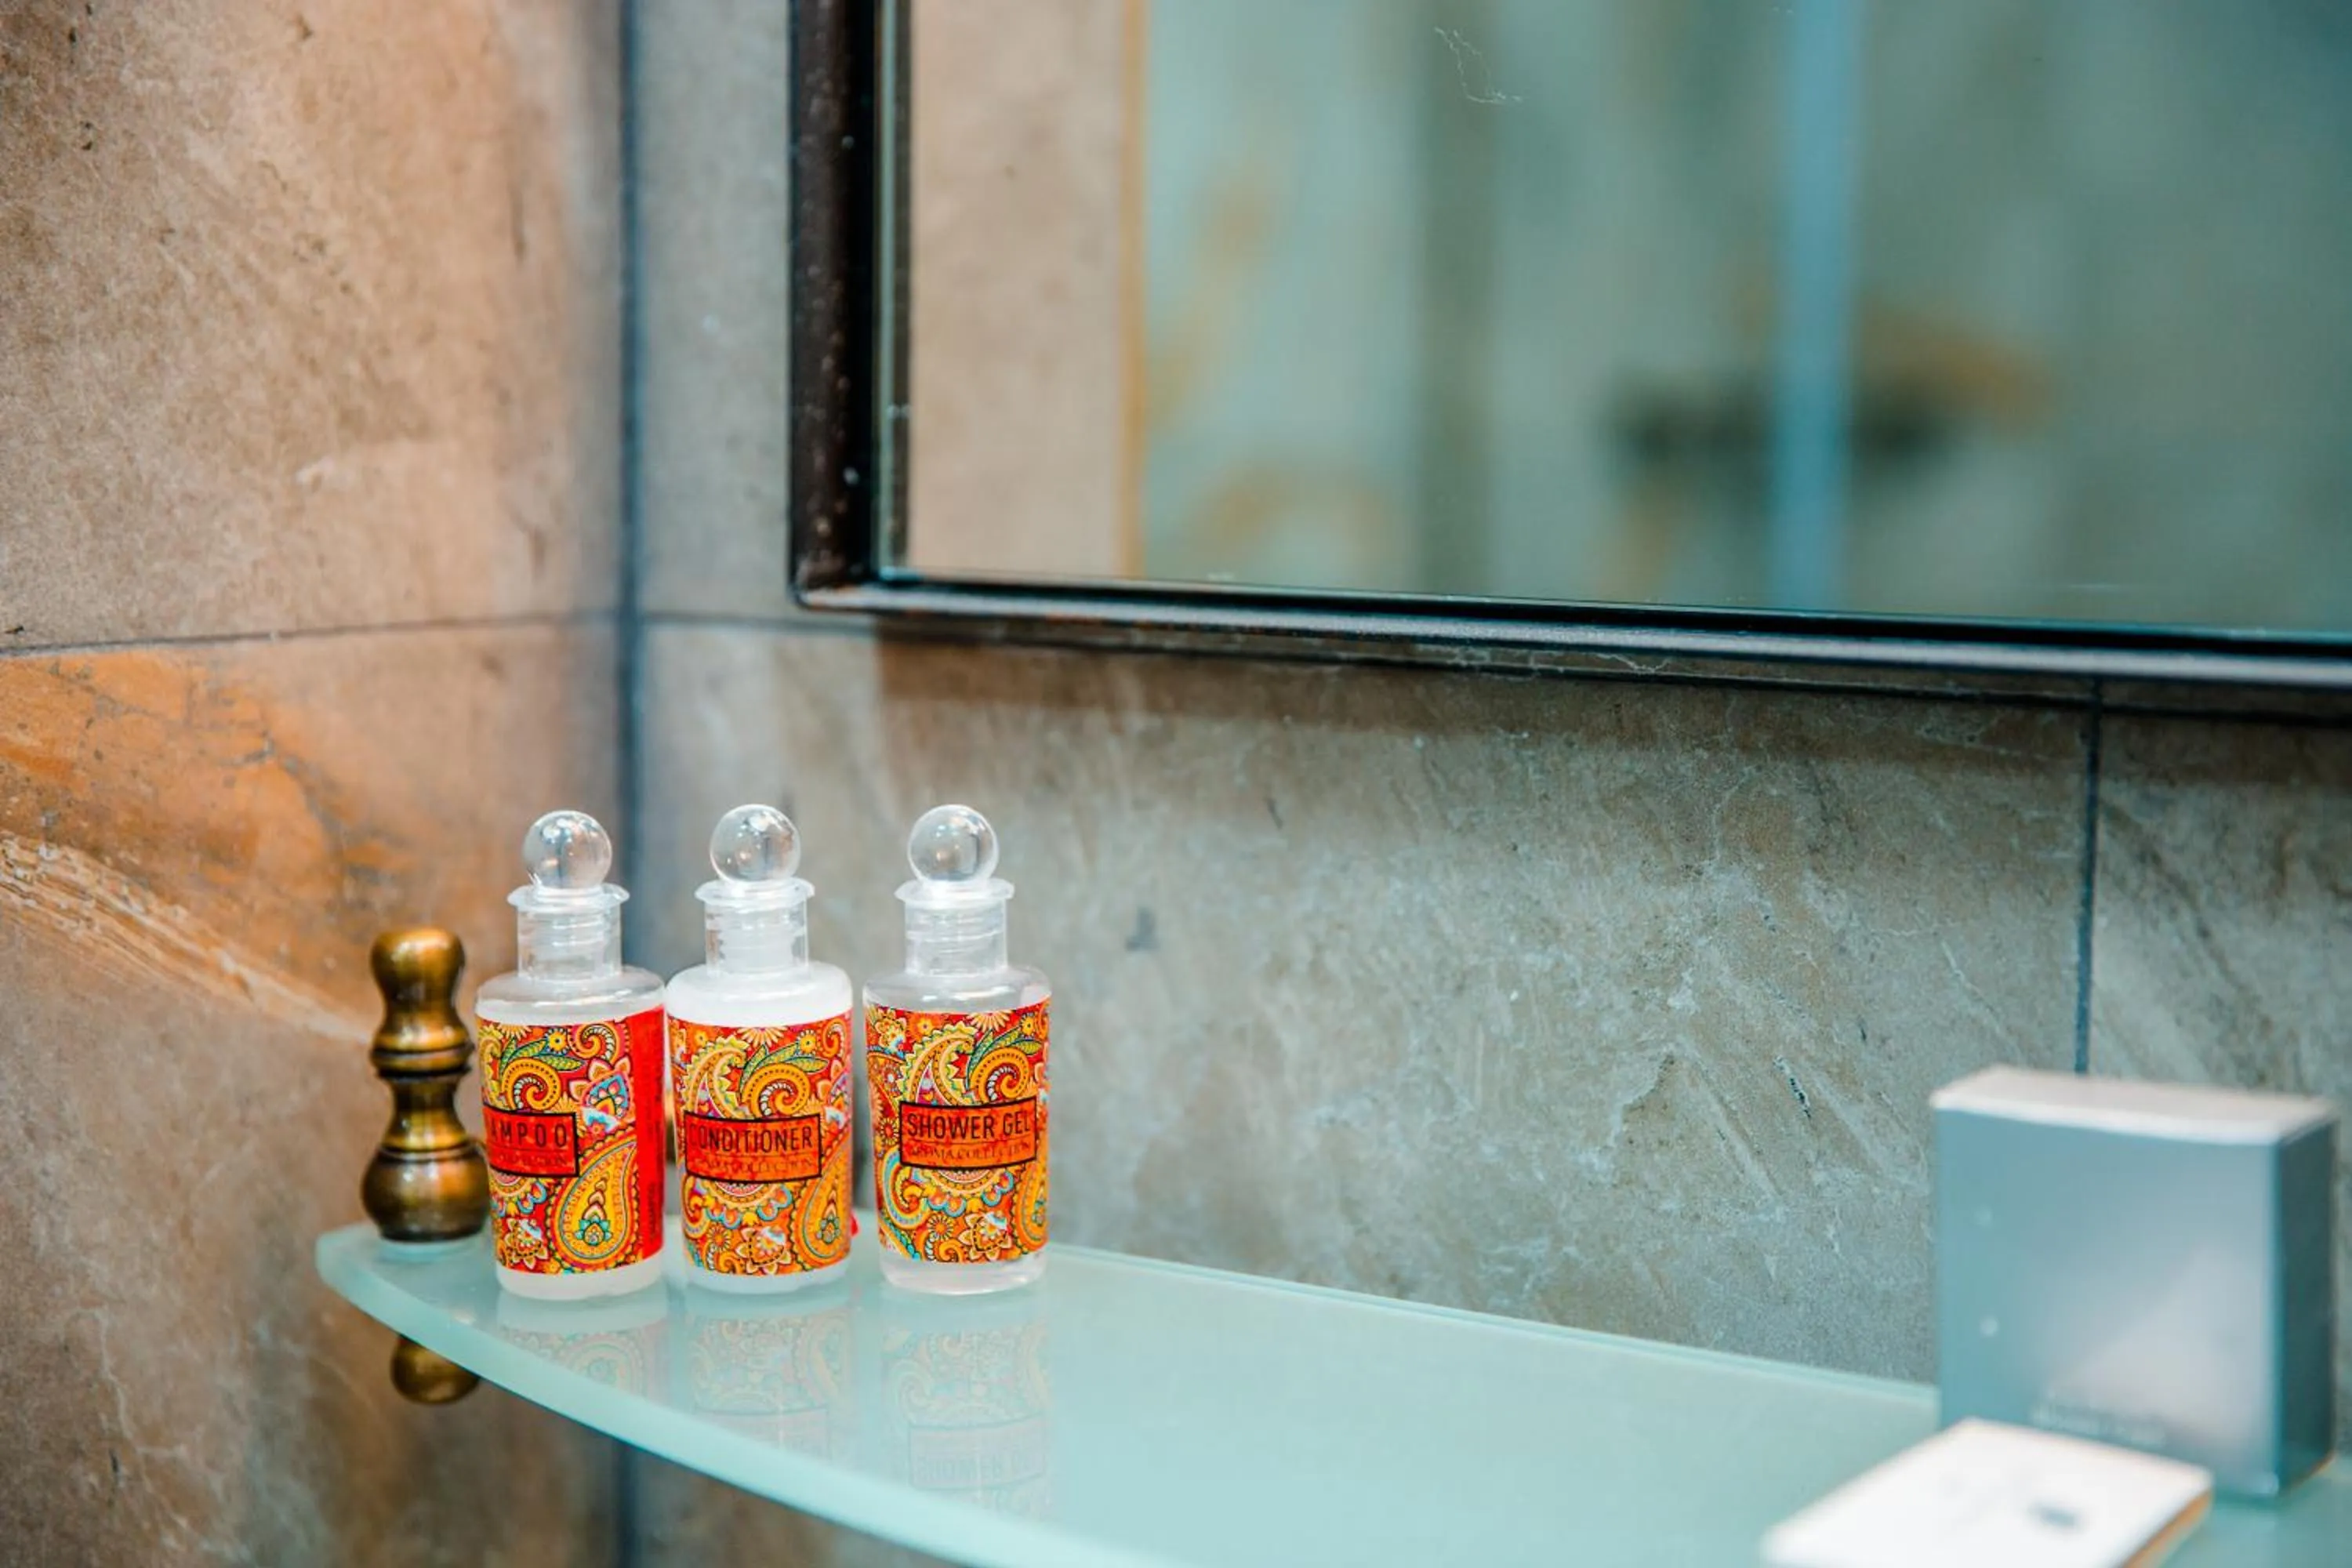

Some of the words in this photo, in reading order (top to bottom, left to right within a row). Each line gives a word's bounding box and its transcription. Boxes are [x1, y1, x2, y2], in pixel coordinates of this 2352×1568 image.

[490, 1117, 568, 1149] AMPOO
[688, 1123, 813, 1153] CONDITIONER
[907, 1112, 995, 1140] SHOWER
[1003, 1109, 1031, 1137] GEL
